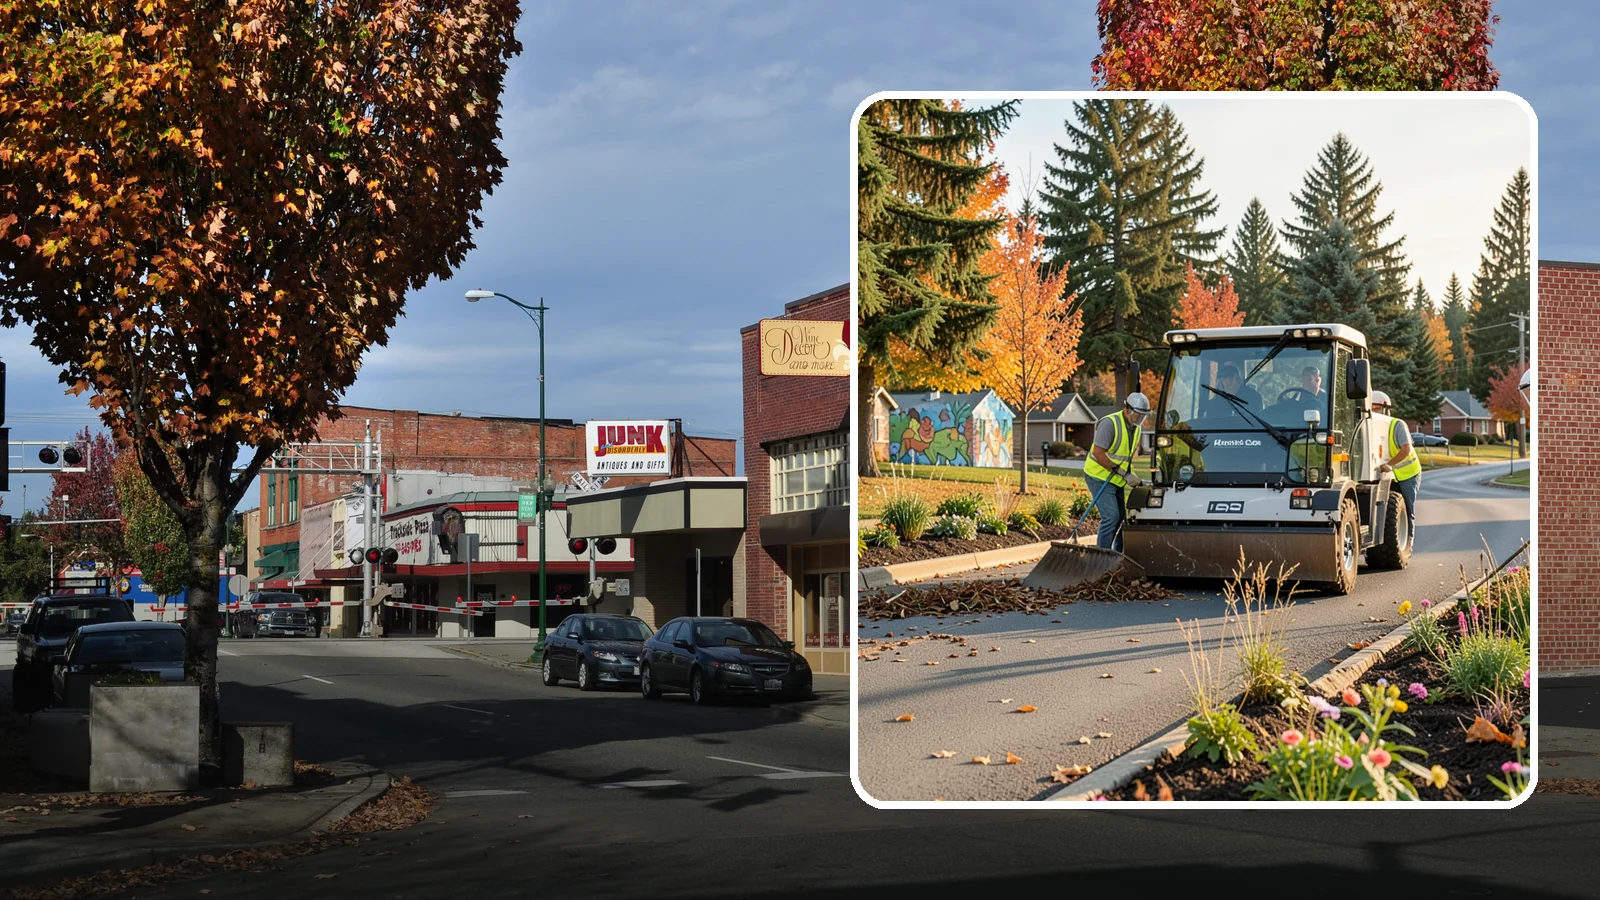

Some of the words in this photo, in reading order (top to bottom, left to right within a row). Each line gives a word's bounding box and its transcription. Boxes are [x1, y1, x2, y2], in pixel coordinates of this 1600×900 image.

[765, 327, 831, 365] Decor
[595, 425, 665, 457] JUNK
[607, 446, 646, 454] DISORDERLY
[596, 461, 628, 470] ANTIQUES
[631, 461, 644, 470] AND
[647, 460, 665, 469] GIFTS
[389, 521, 413, 540] Trackside
[414, 519, 429, 535] Pizza
